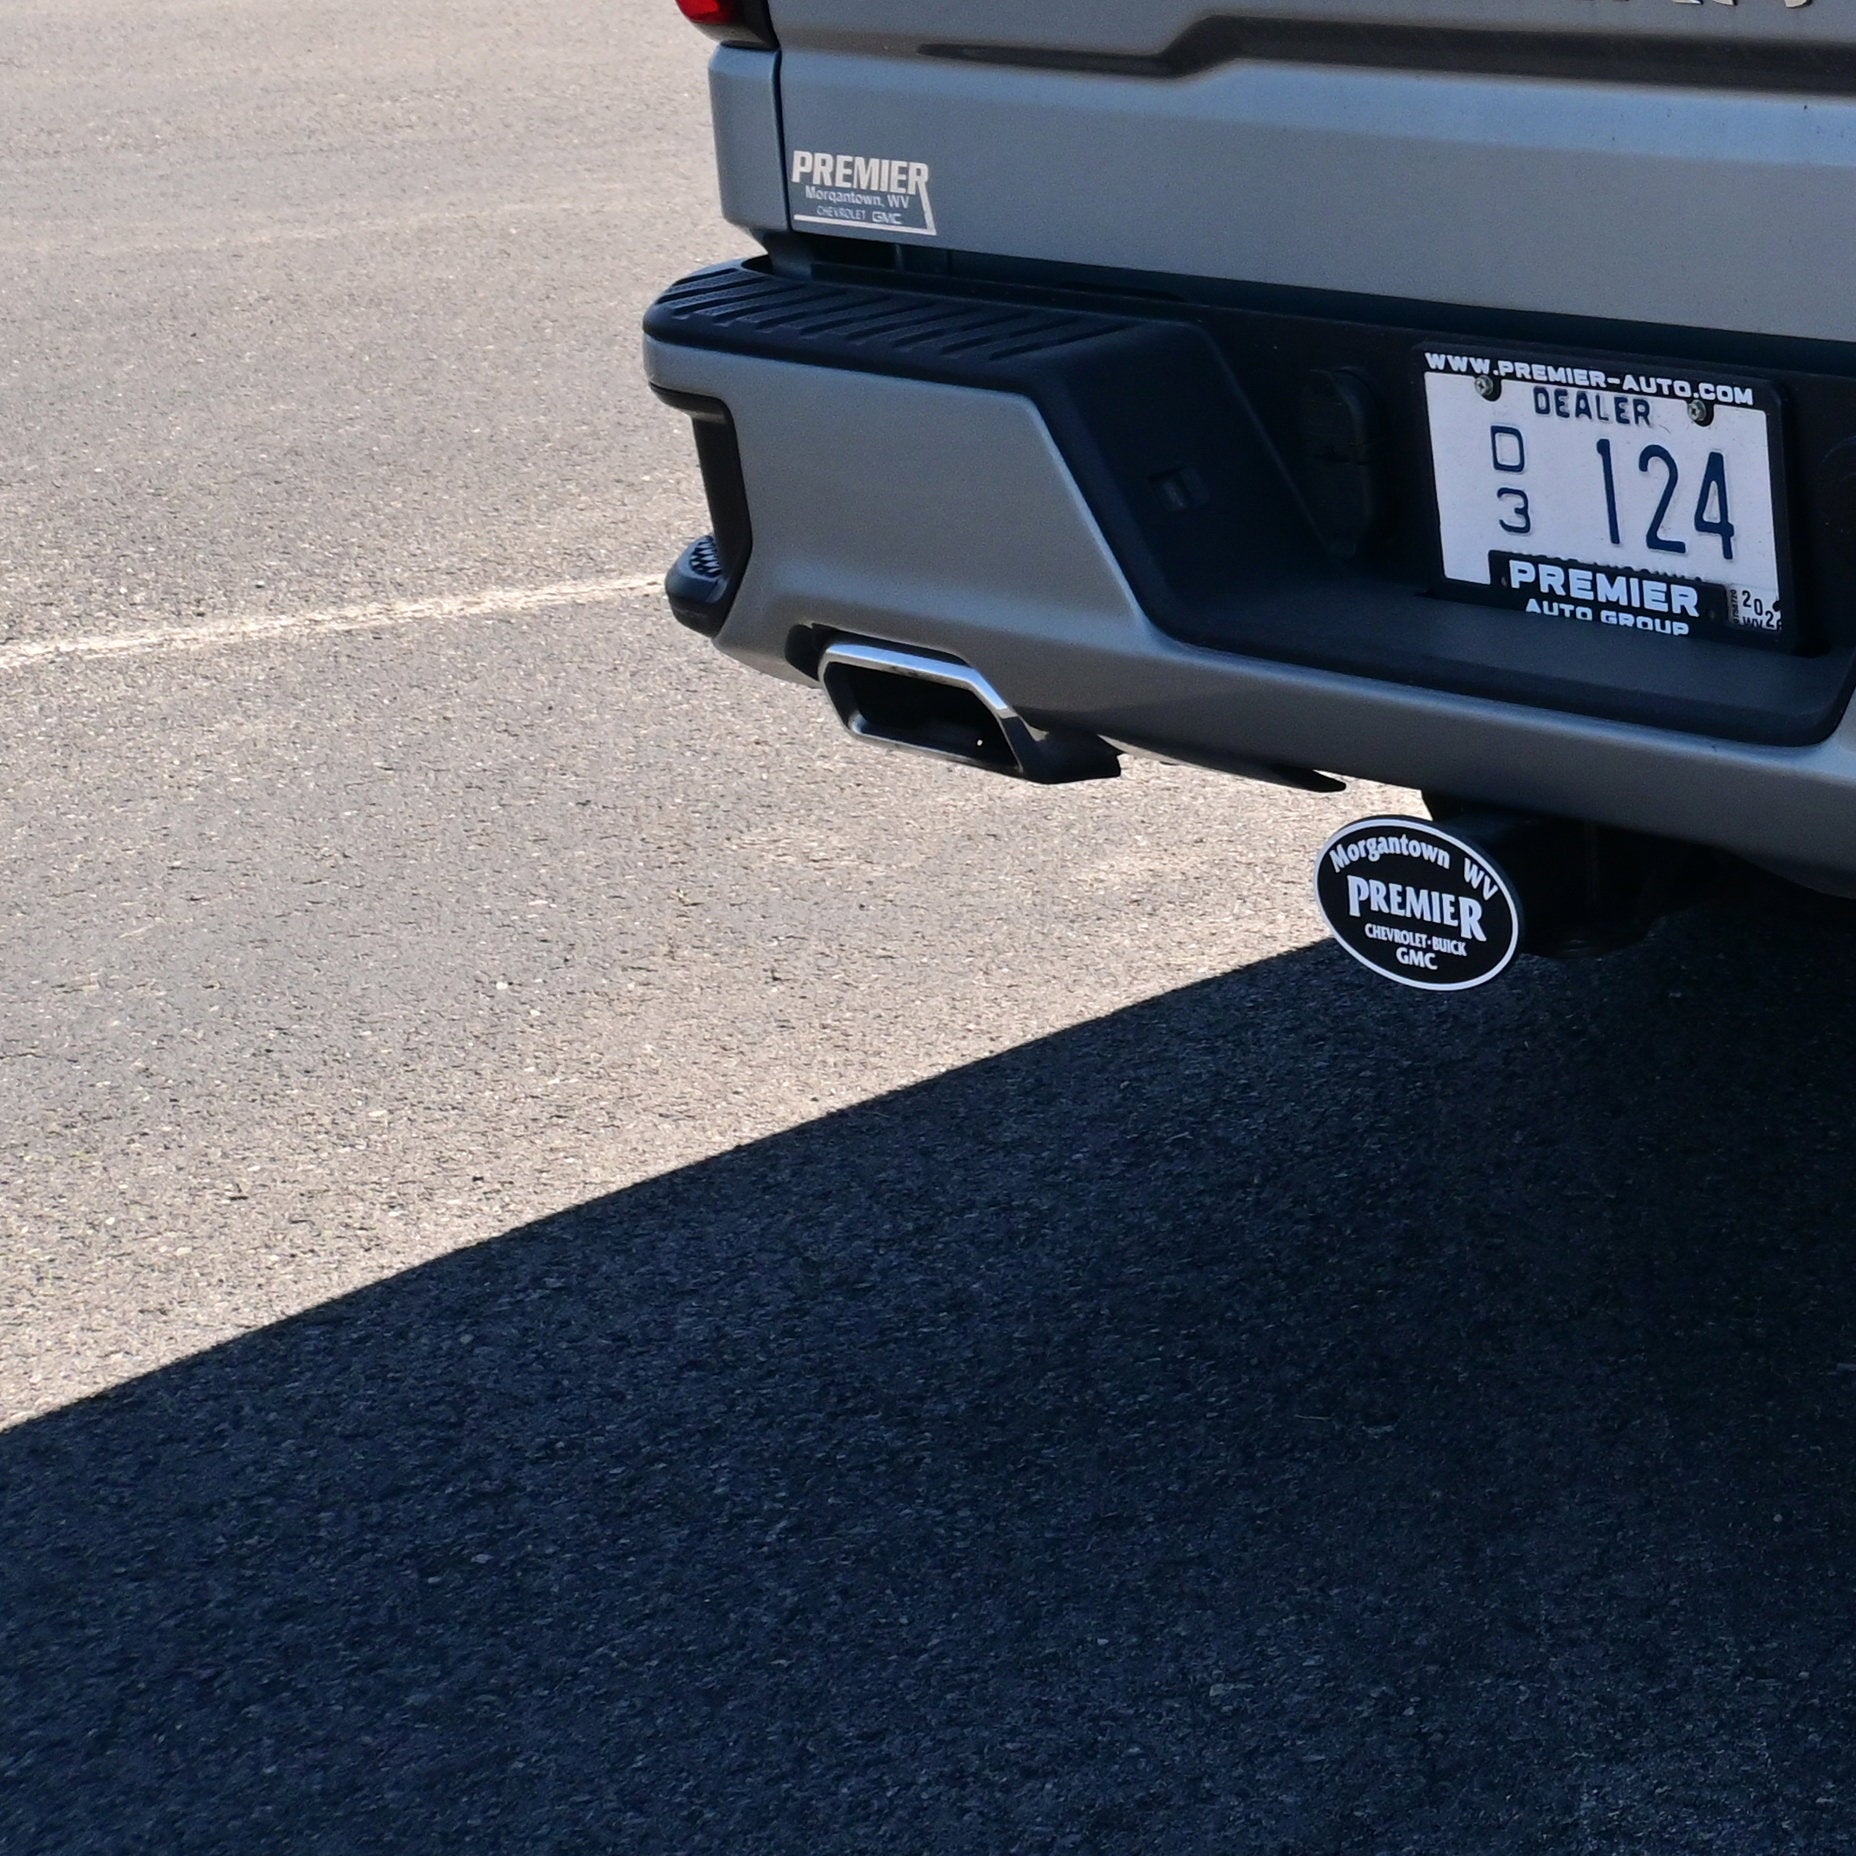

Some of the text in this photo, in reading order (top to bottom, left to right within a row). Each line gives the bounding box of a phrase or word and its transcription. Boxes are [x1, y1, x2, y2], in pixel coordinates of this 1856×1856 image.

[791, 150, 930, 195] PREMIER
[816, 205, 903, 225] CHEVROLET GMC
[887, 195, 910, 209] WV
[1424, 352, 1753, 406] WWW.PREMIER-AUTO.COM
[1533, 386, 1652, 425] DEALER
[1497, 487, 1532, 534] 3
[1596, 438, 1735, 560] 124
[1509, 559, 1699, 617] PREMIER
[1525, 599, 1690, 637] AUTO GROUP
[1329, 834, 1499, 901] Morgantown WV
[1347, 875, 1487, 942] PREMIER
[1396, 947, 1439, 971] GMC
